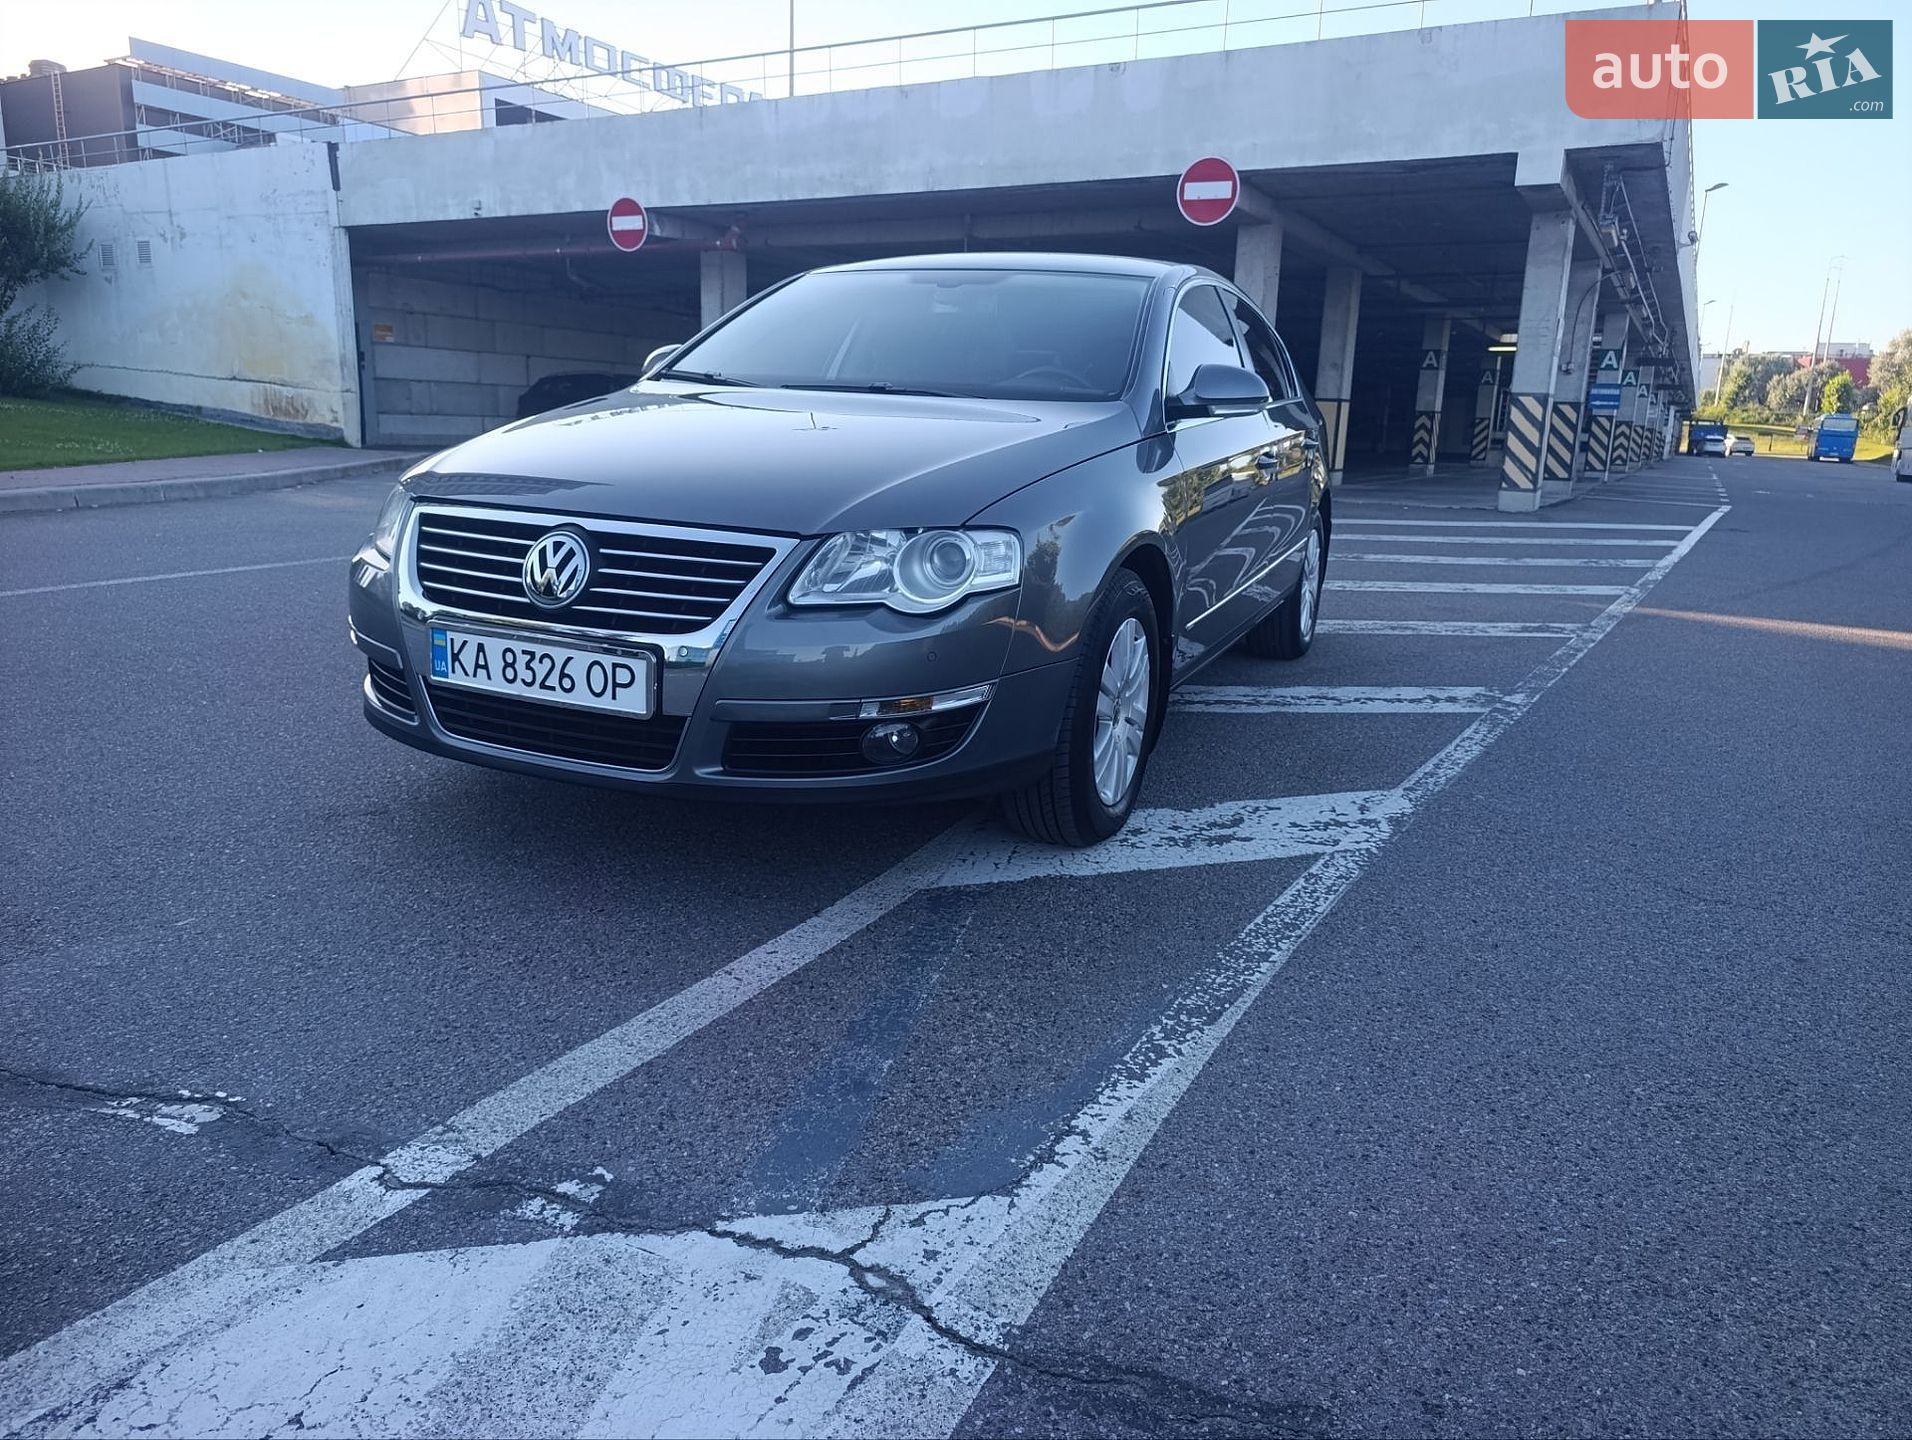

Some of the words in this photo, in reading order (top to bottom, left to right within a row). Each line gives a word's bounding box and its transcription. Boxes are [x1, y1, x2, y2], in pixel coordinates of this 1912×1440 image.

[1422, 351, 1438, 367] A
[1600, 350, 1618, 369] A
[1622, 371, 1637, 386] A
[526, 536, 587, 603] VW
[435, 662, 447, 673] UA
[450, 638, 491, 681] KA
[502, 647, 576, 694] 8326
[586, 659, 636, 701] OP
